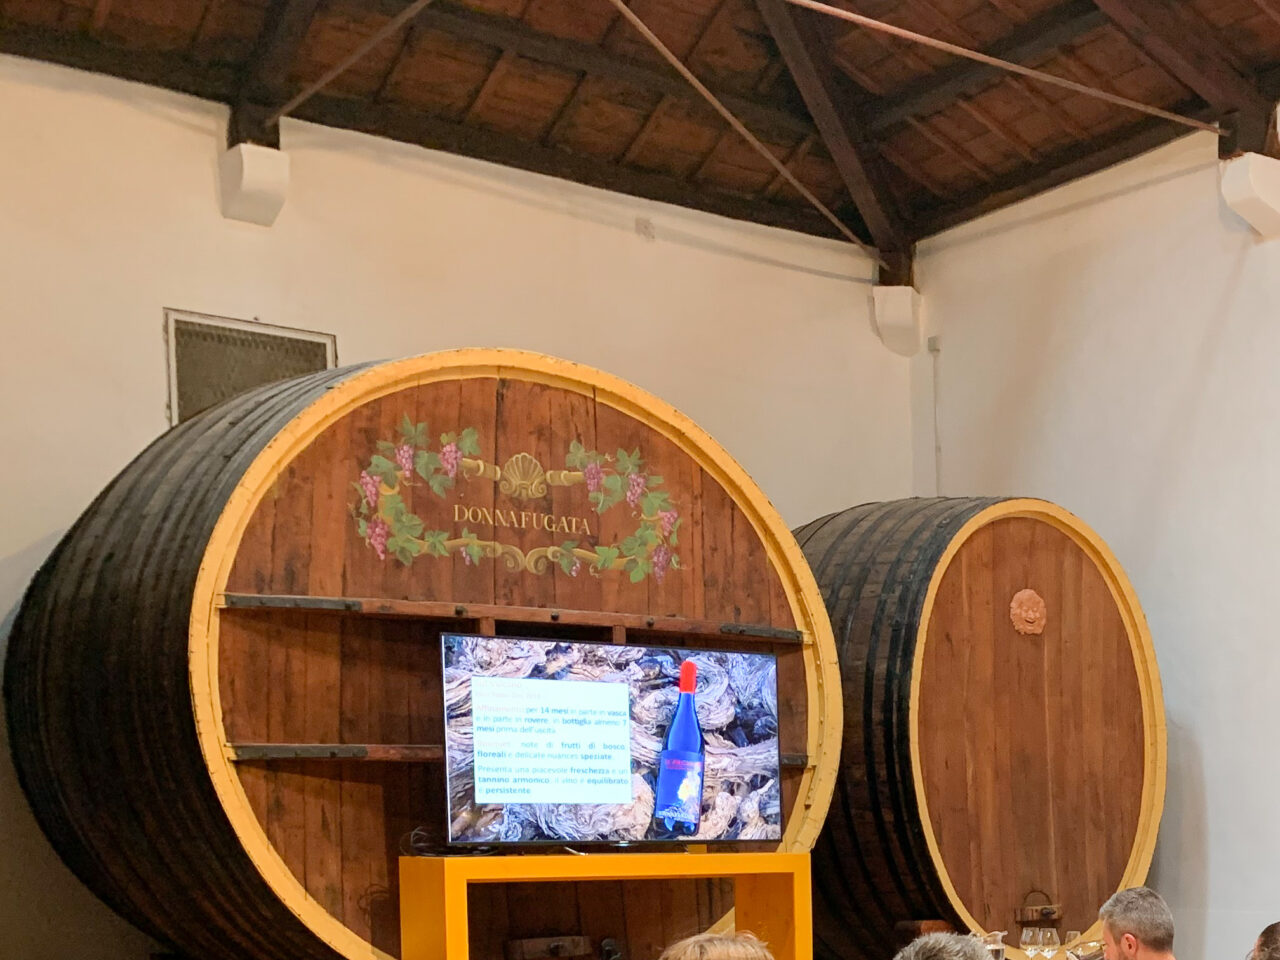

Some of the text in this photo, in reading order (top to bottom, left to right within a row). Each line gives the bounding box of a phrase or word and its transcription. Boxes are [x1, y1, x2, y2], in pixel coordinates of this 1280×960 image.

[453, 504, 592, 536] DONNAFUGATA
[562, 717, 592, 726] bottiglia
[570, 767, 610, 775] freschezza
[587, 777, 628, 786] equilibrato
